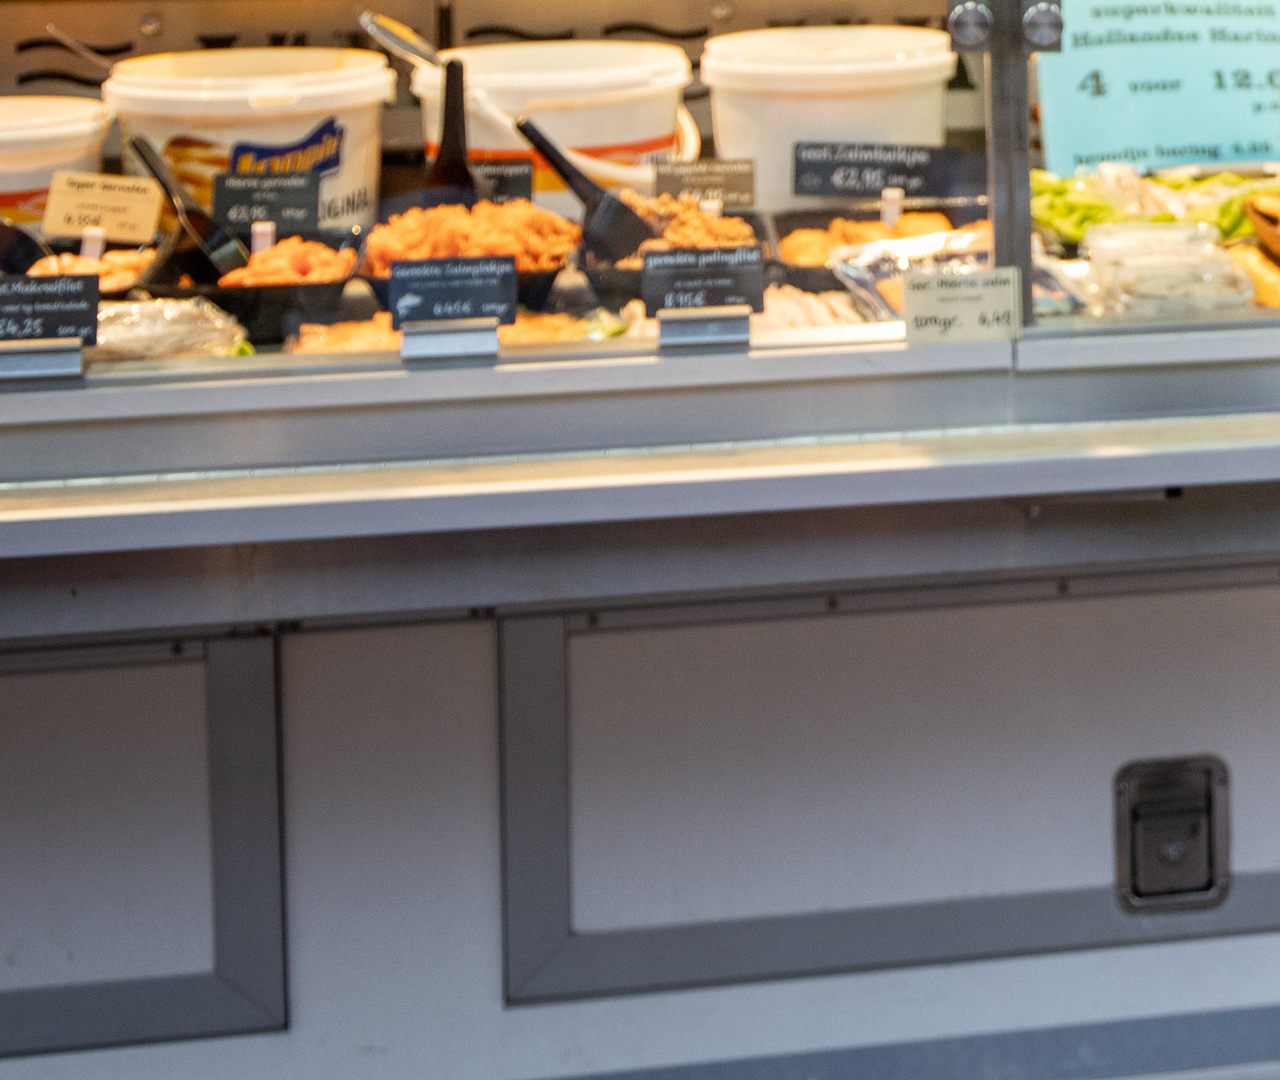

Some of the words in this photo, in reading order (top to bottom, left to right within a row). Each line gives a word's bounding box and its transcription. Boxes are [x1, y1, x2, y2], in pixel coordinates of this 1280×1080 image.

[1092, 1, 1276, 21] superkwaliteit
[1071, 28, 1199, 48] Hollandse
[1078, 70, 1107, 97] 4
[1128, 78, 1181, 94] voor
[1154, 142, 1221, 159] haring
